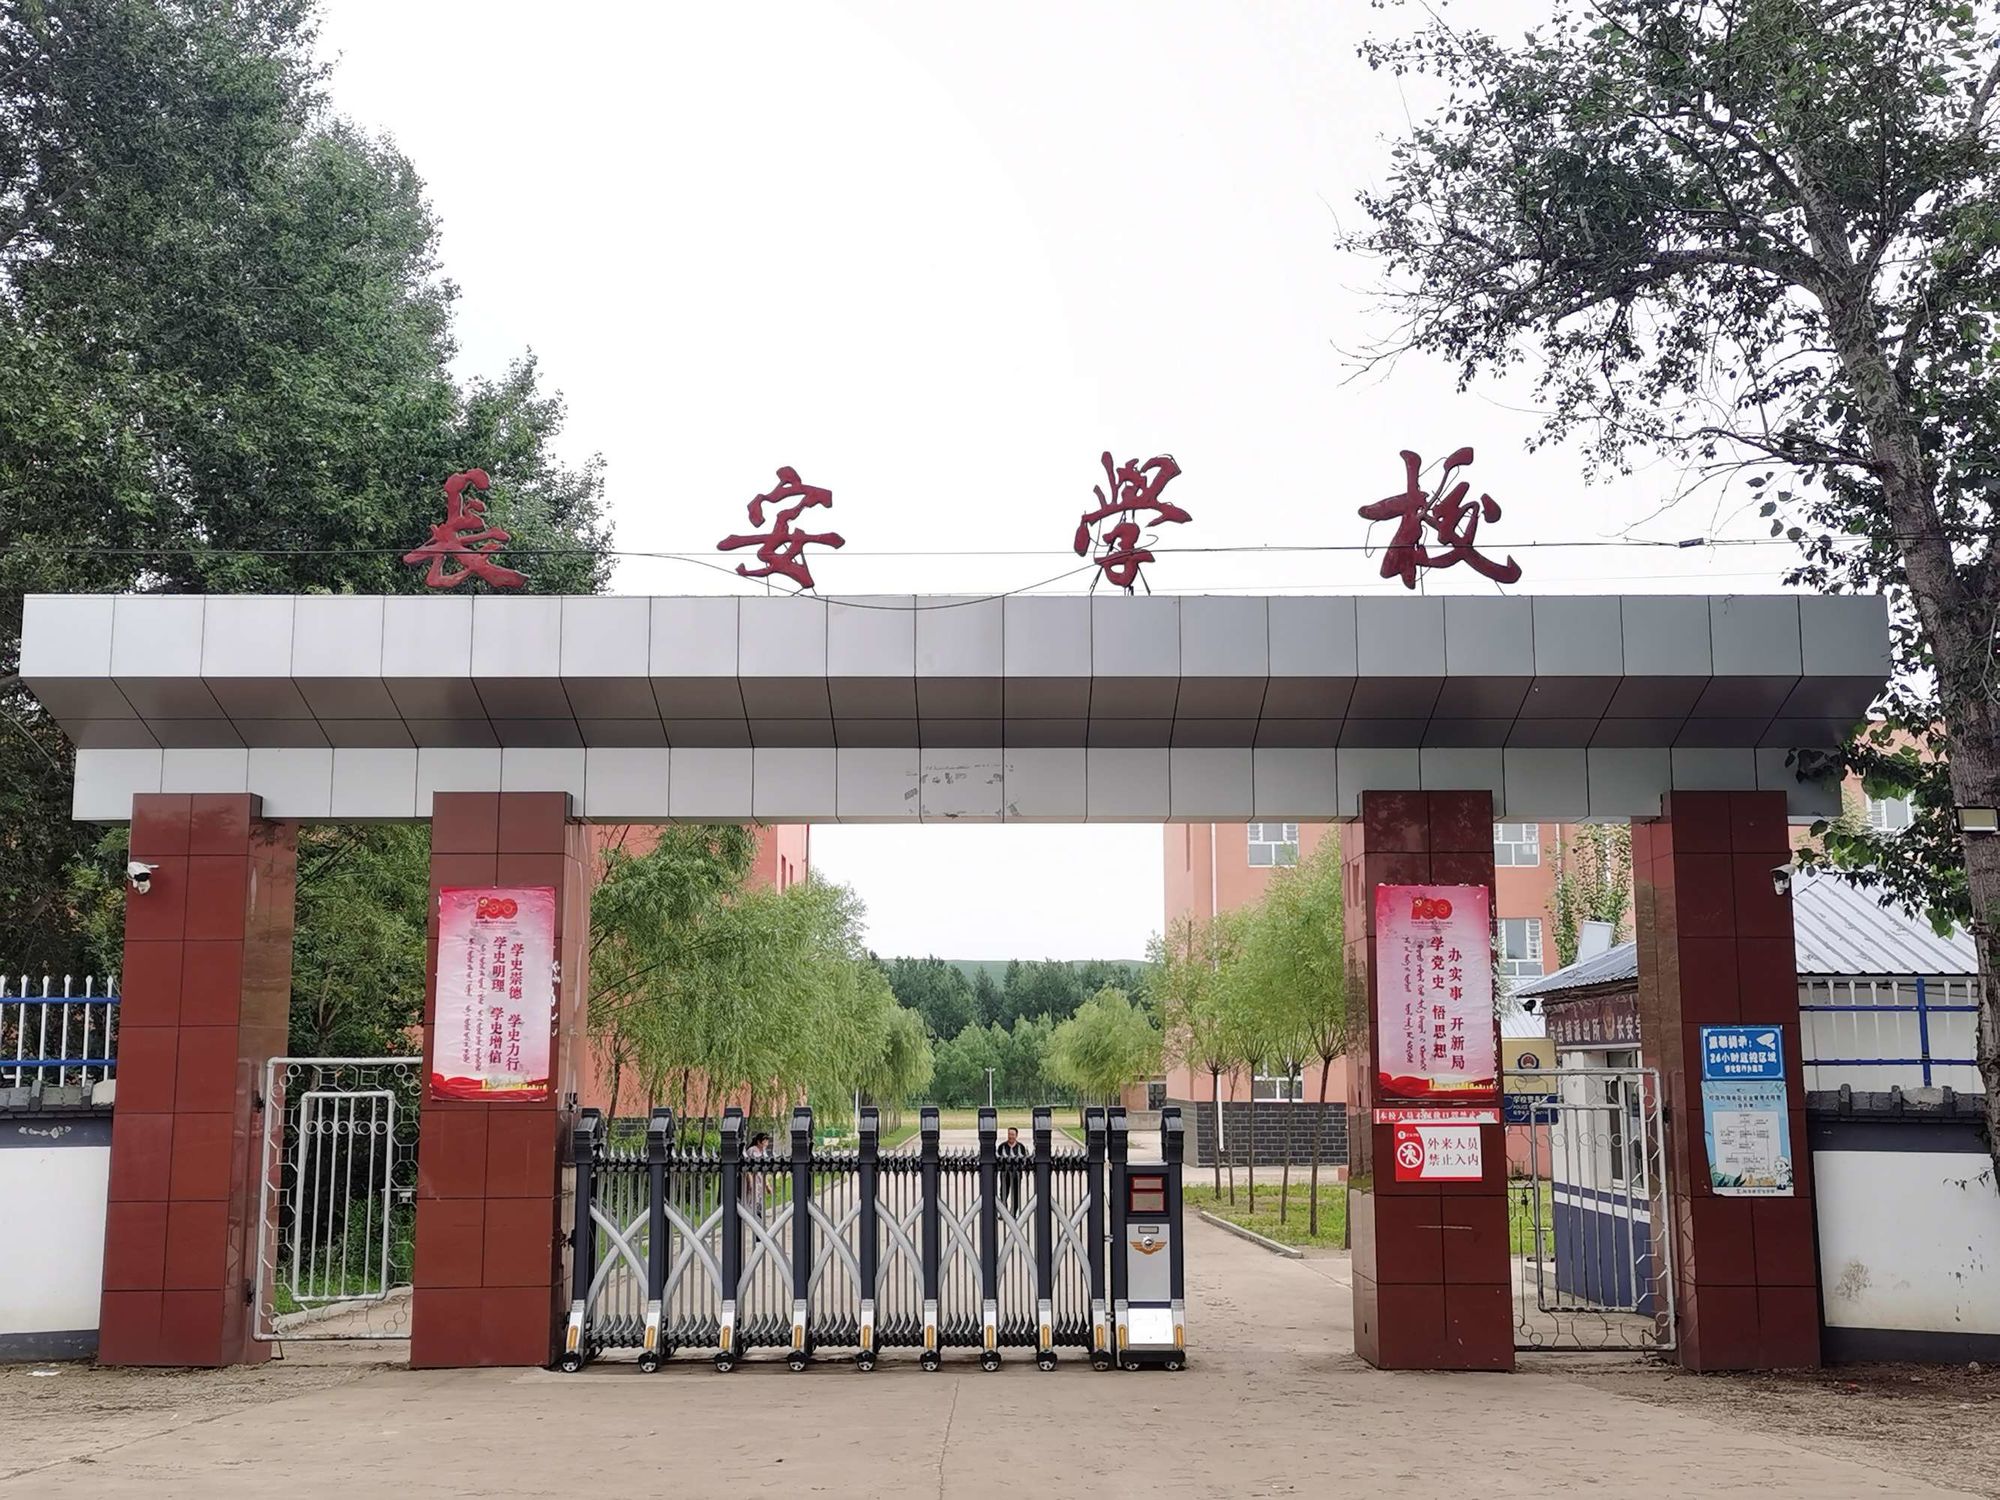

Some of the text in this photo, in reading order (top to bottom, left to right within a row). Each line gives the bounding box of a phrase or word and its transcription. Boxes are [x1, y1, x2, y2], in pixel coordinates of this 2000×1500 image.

[488, 936, 508, 1064] 学史明理 学史增信
[505, 943, 524, 1071] 学史崇德 学史力行
[1430, 936, 1447, 1059] 学党史 悟思想
[1448, 948, 1465, 1070] 办实事 开新局
[1427, 1137, 1479, 1151] 外来人员
[1428, 1153, 1479, 1167] 禁止入内
